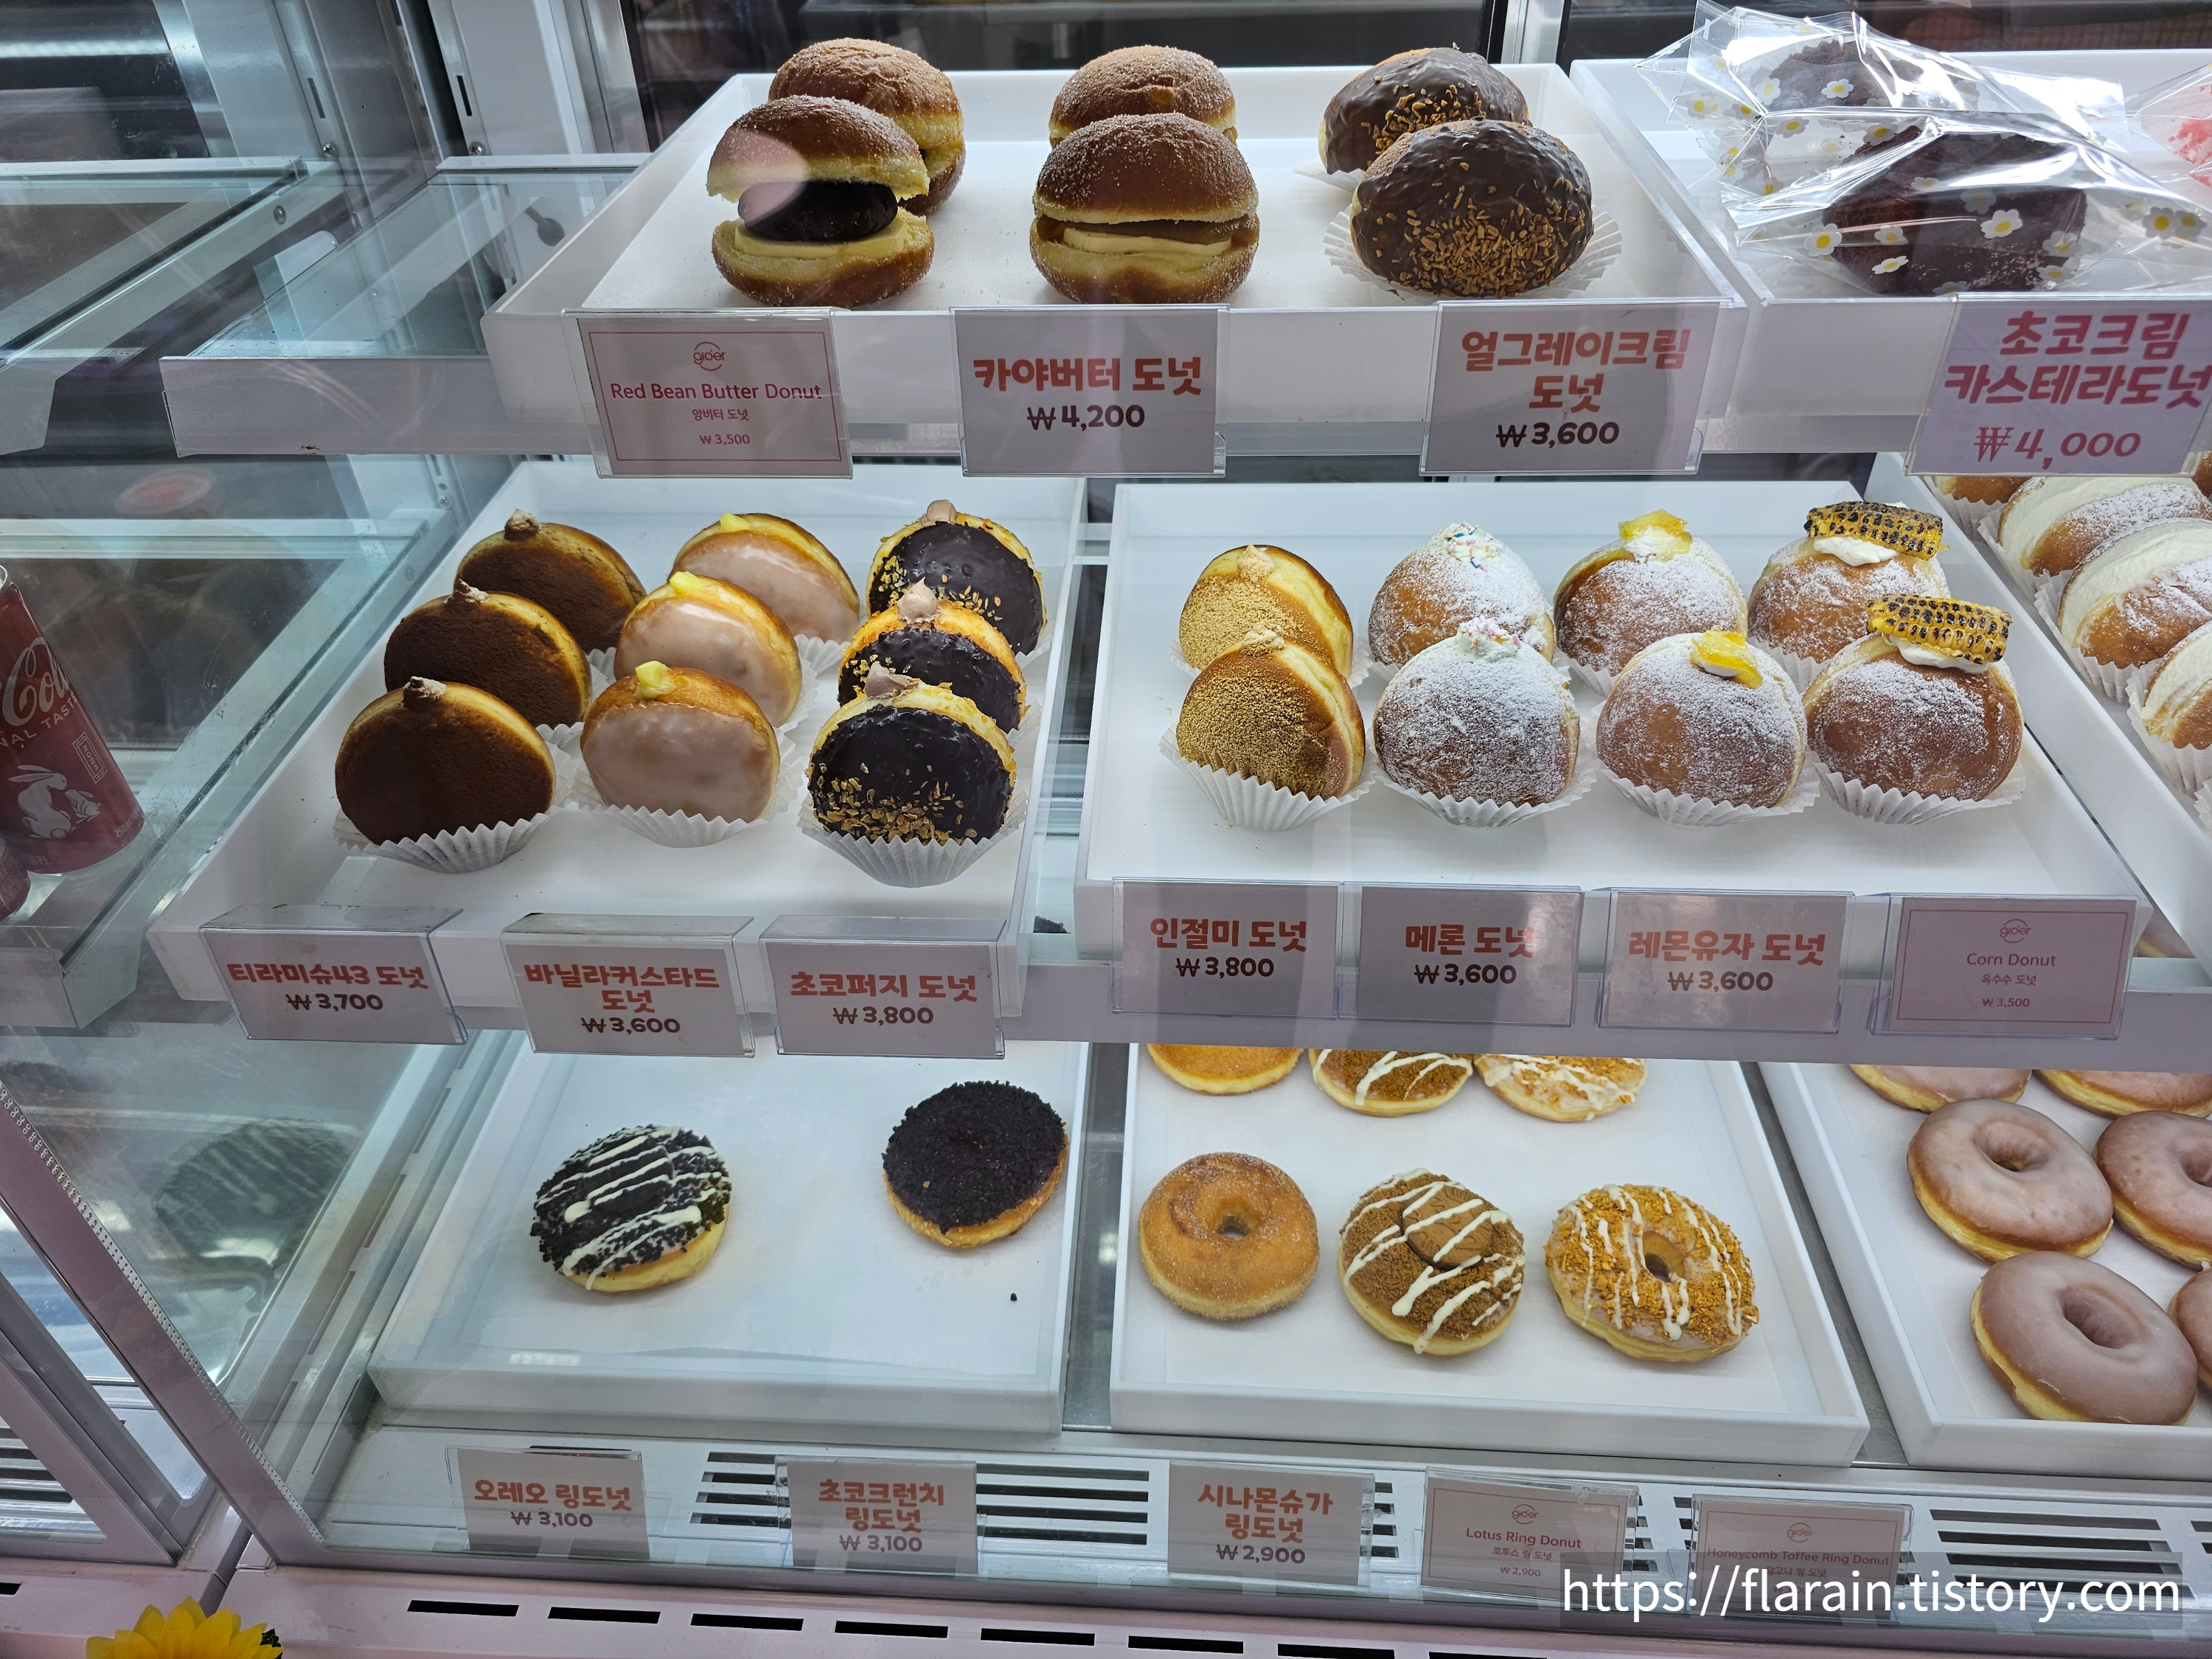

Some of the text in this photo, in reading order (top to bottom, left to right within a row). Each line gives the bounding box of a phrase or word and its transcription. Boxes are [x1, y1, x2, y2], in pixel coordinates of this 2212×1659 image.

[2000, 310, 2190, 360] 초코크림
[1461, 329, 1691, 372] 얼그레이크림
[973, 357, 1202, 396] 카야버터 도넛
[611, 383, 822, 399] Red Bean Butter Donut
[1528, 373, 1604, 414] 도넛
[692, 408, 749, 421] 앙버터 도넛
[1150, 918, 1307, 953] 인절미 도넛
[1405, 924, 1534, 958] 메론 도넛
[1629, 931, 1826, 966] 레몬유자 도넛
[1966, 953, 2056, 967] Corn Donut
[226, 964, 429, 990] 티라미슈43 도넛
[524, 964, 720, 988] 바닐라커스타드
[790, 972, 978, 1002] 초코퍼지 도넛
[1981, 974, 2037, 986] 옥수수 도넛
[601, 990, 655, 1013] 도넛
[475, 1479, 632, 1512] 오레오 링도넛
[818, 1478, 945, 1507] 초코크런치
[1197, 1484, 1334, 1515] 시나몬슈가
[845, 1507, 922, 1533] 링도넛
[1225, 1513, 1304, 1544] 링도넛
[1466, 1527, 1582, 1548] Lotus Ring Donut
[1492, 1547, 1552, 1561] 로투스 링 도넛
[1707, 1548, 1890, 1565] Honeycomb Toffee Ring Donut
[1807, 1568, 1826, 1578] 도넛
